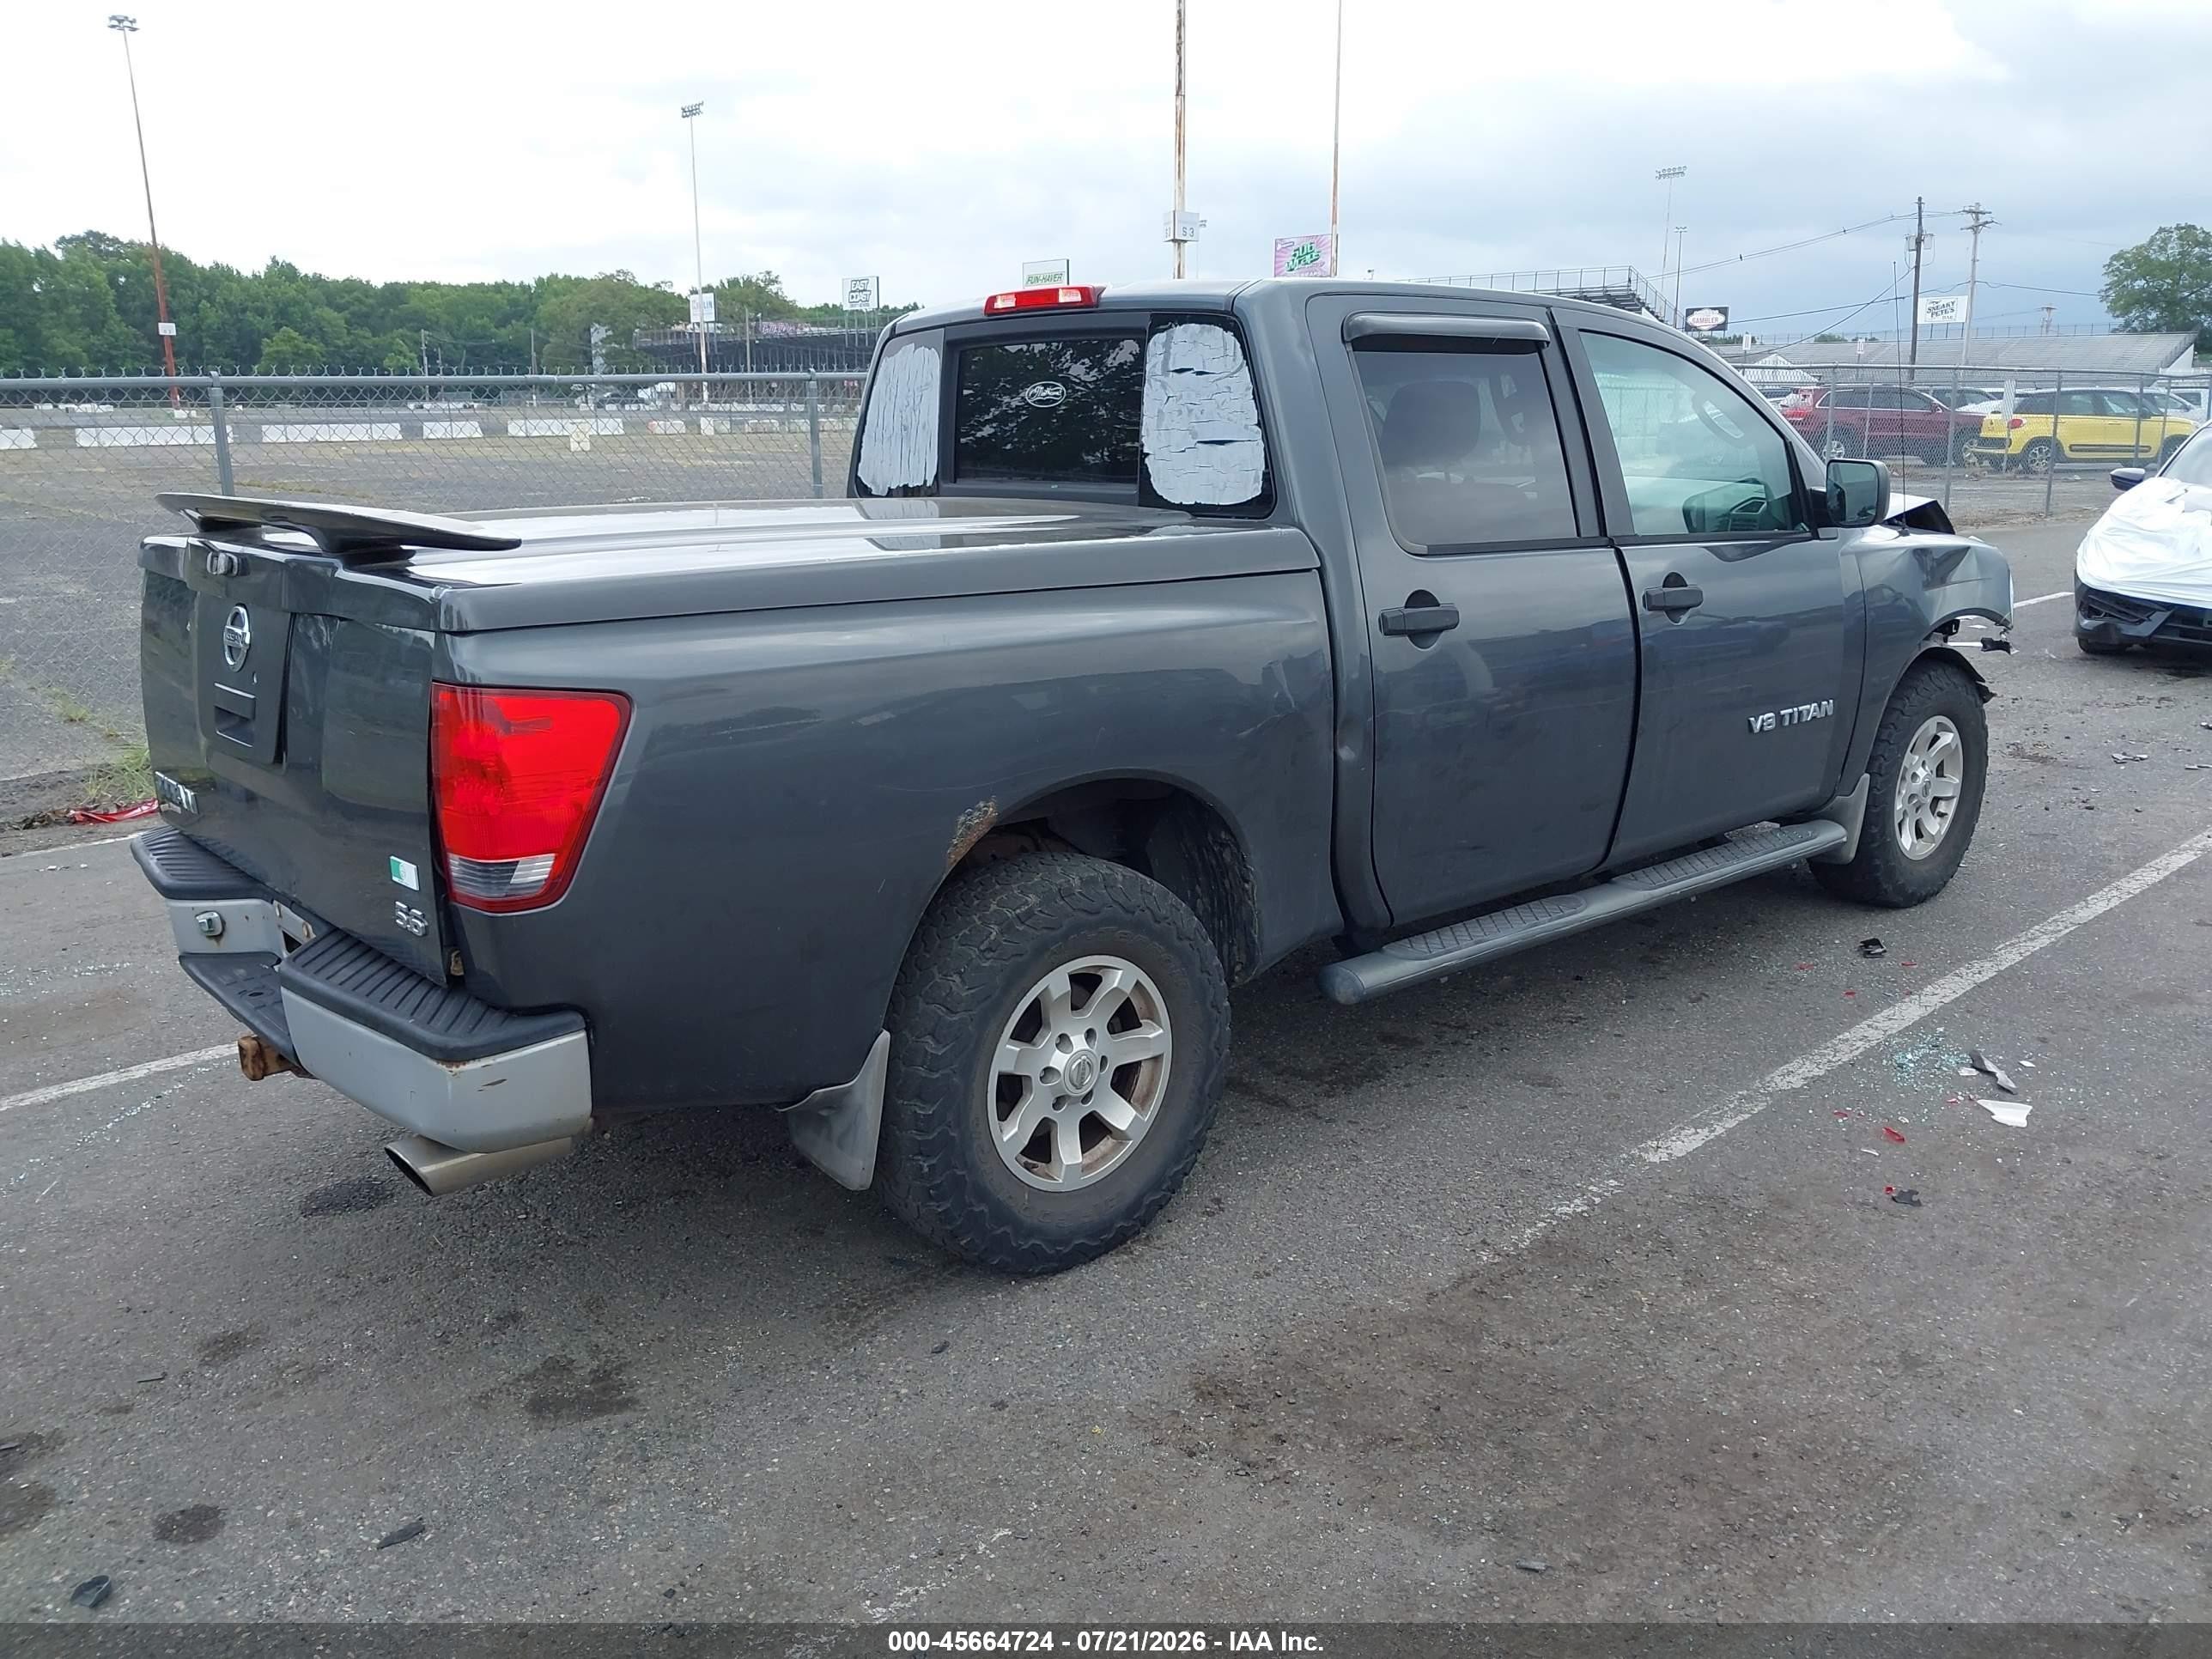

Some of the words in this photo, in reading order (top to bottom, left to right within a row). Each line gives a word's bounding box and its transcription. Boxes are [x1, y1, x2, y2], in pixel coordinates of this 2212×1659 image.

[850, 278, 869, 291] EAST
[848, 290, 872, 303] COAST
[1926, 301, 1956, 314] SNEAKY
[1748, 712, 1776, 733] V8
[1780, 699, 1833, 726] TITAN
